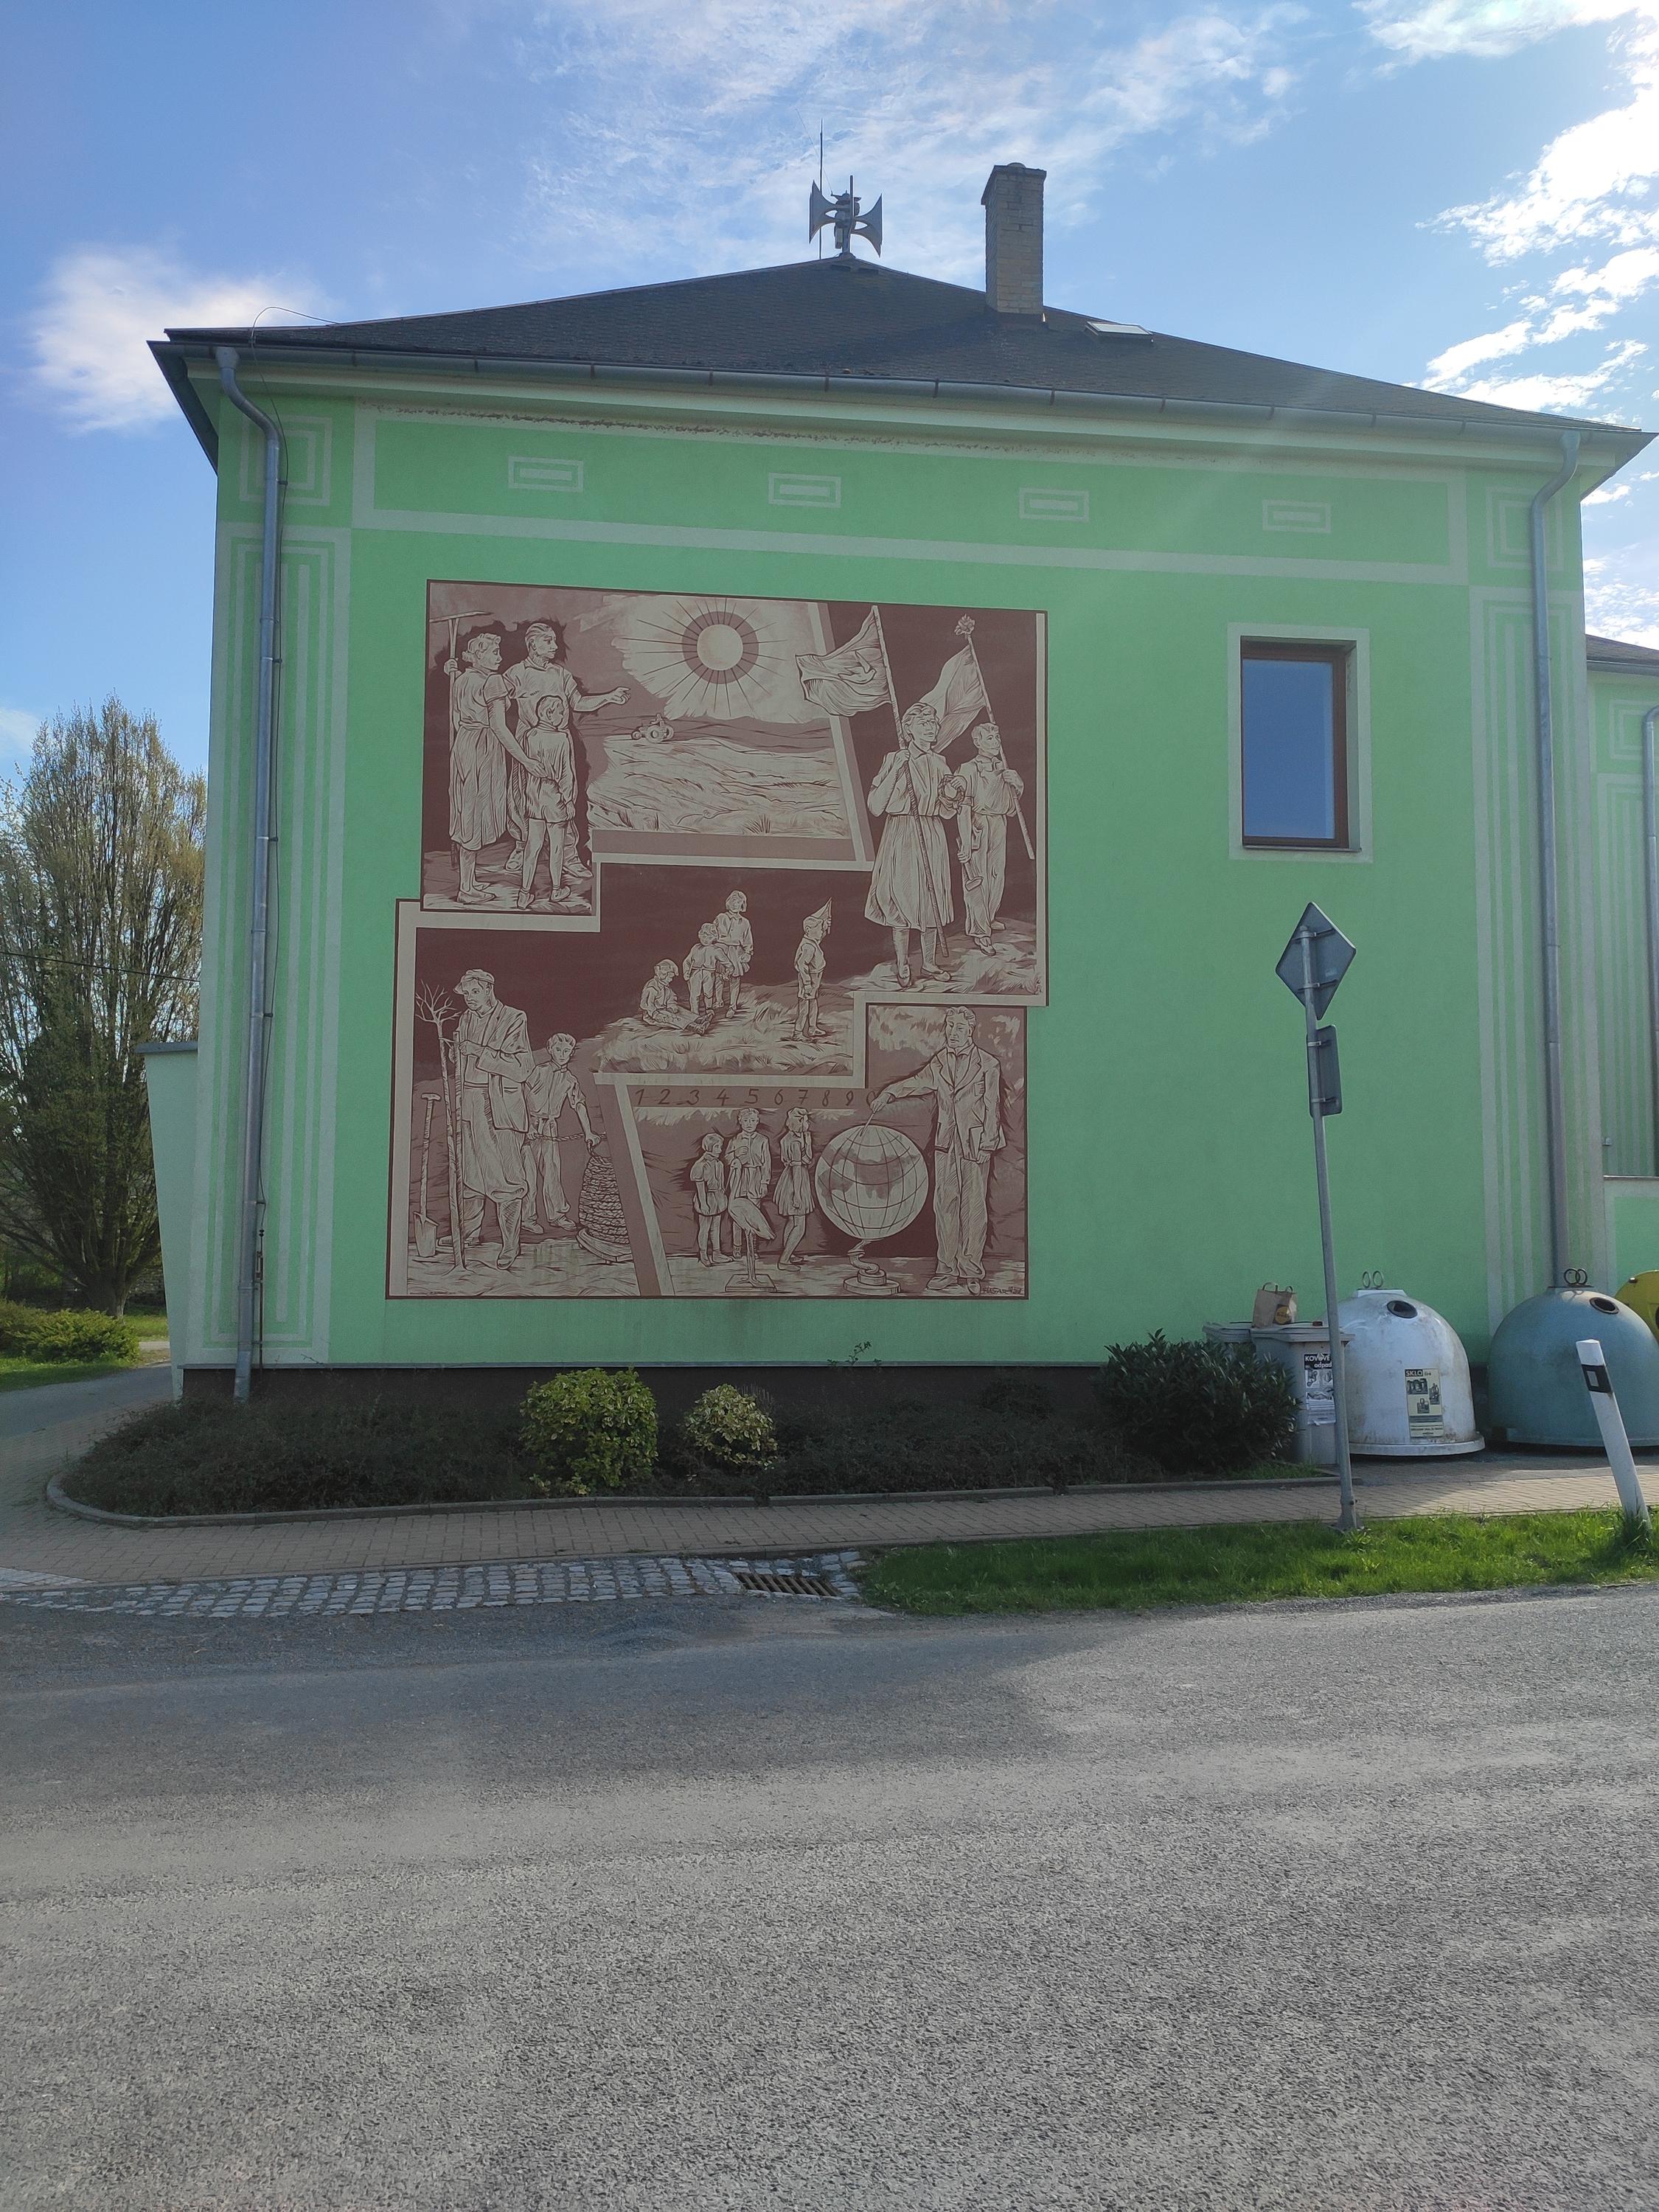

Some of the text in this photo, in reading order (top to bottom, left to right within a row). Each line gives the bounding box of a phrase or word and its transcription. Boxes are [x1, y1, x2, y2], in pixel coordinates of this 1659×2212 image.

[635, 1089, 645, 1105] 1
[658, 1089, 670, 1105] 2
[687, 1090, 700, 1105] 3
[716, 1088, 729, 1106] 4
[744, 1088, 759, 1104] 5
[774, 1089, 783, 1105] 6
[798, 1090, 809, 1105] 7
[822, 1091, 830, 1107] 8
[846, 1090, 854, 1106] 9
